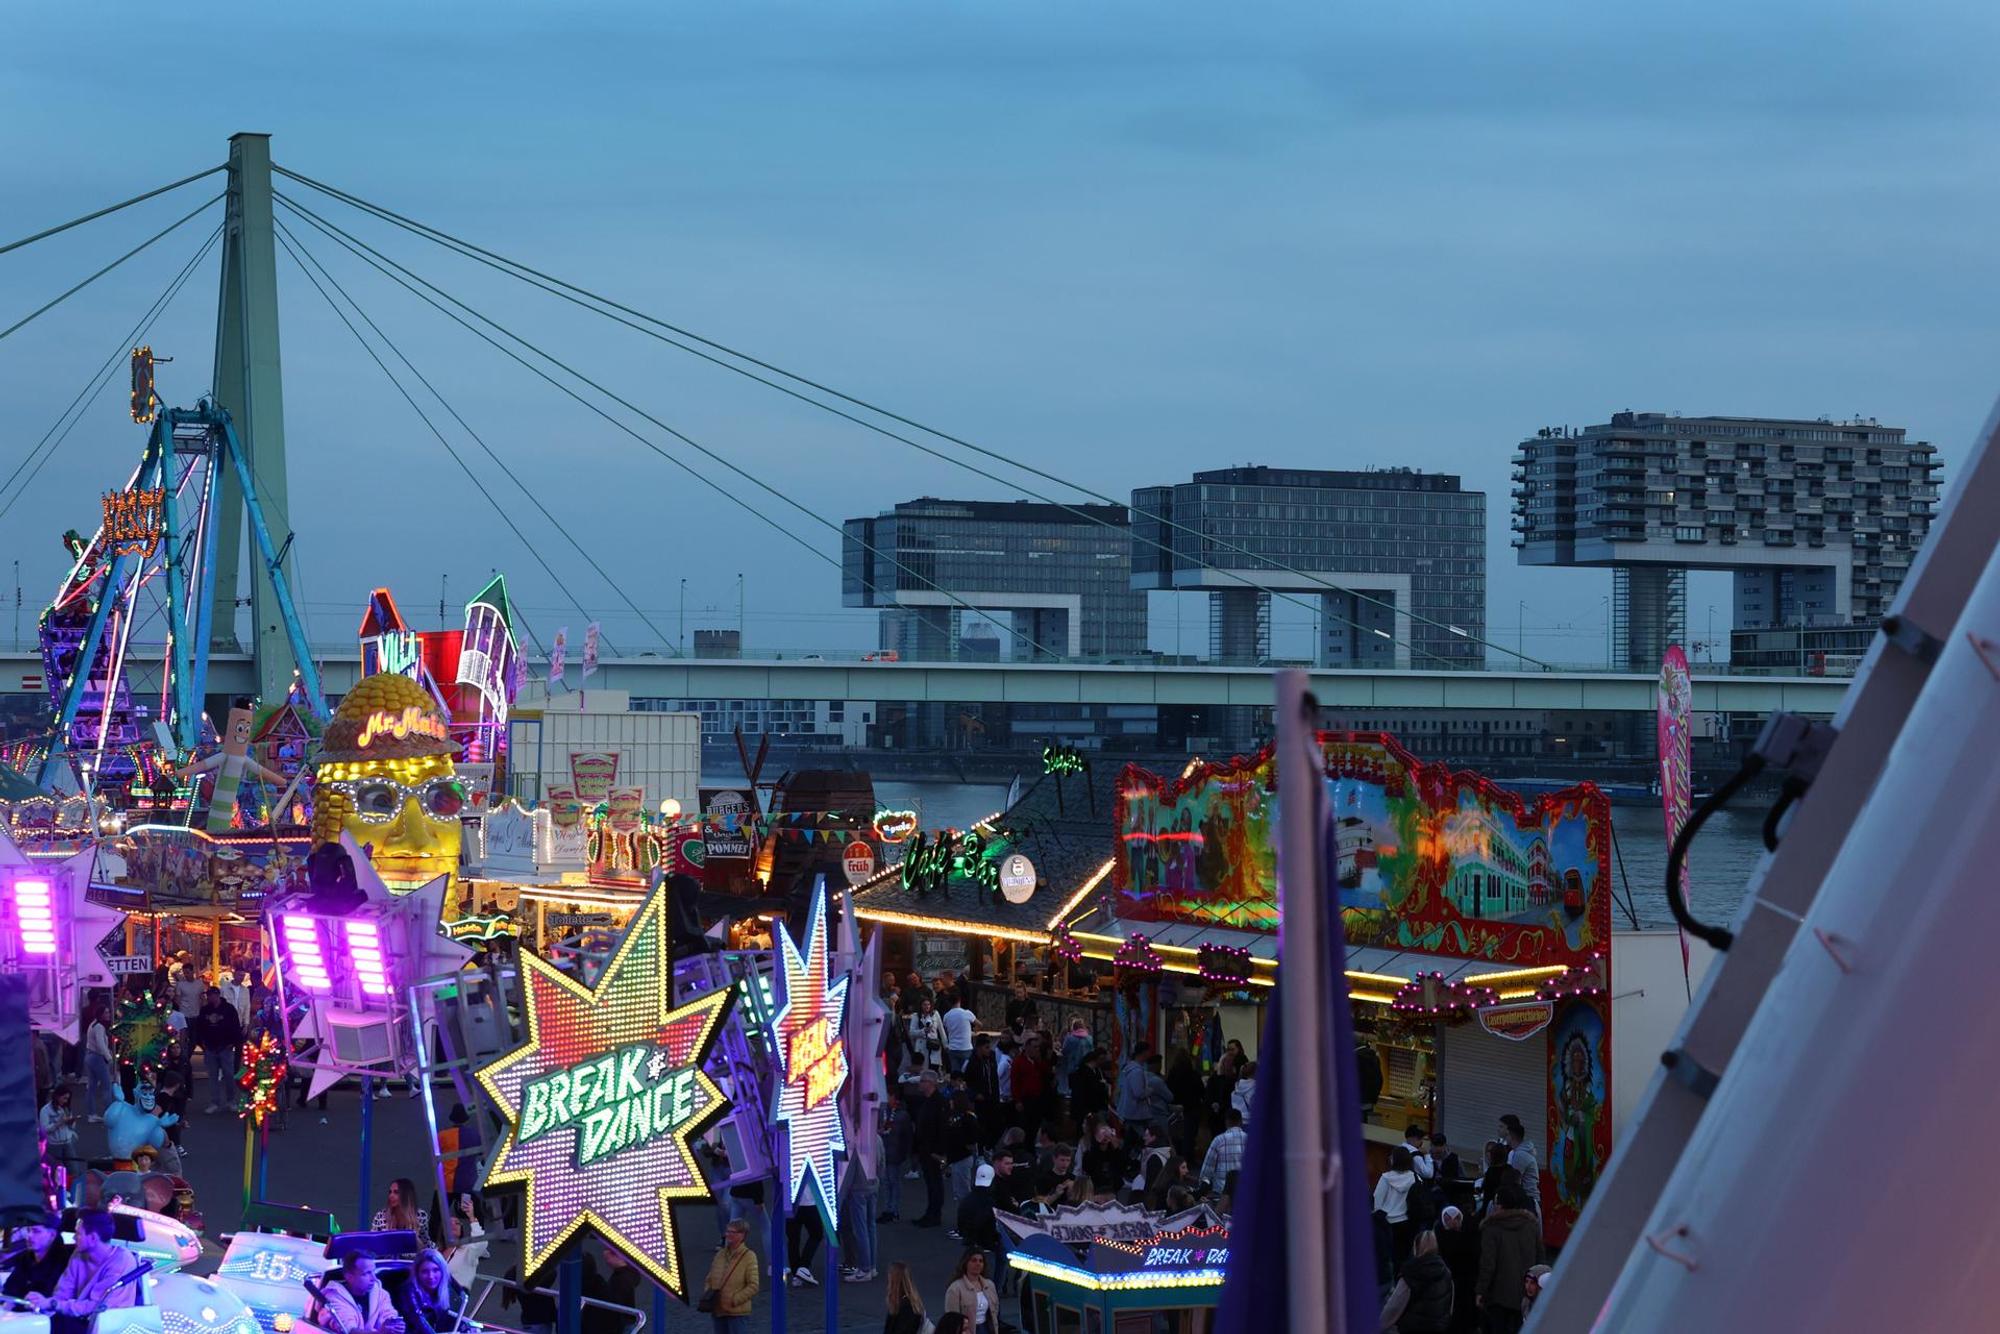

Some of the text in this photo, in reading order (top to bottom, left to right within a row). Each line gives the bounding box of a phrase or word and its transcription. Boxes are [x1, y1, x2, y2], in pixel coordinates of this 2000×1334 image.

[377, 631, 416, 675] VILLA
[357, 706, 446, 748] Mr. Mais
[706, 801, 751, 817] BURGERS
[704, 824, 714, 834] &
[706, 843, 748, 855] POMMES
[550, 915, 592, 925] Toilette
[519, 1048, 648, 1142] BREAK
[580, 1069, 695, 1164] DANCE
[250, 1251, 292, 1281] 15
[1144, 1249, 1193, 1266] BREAK
